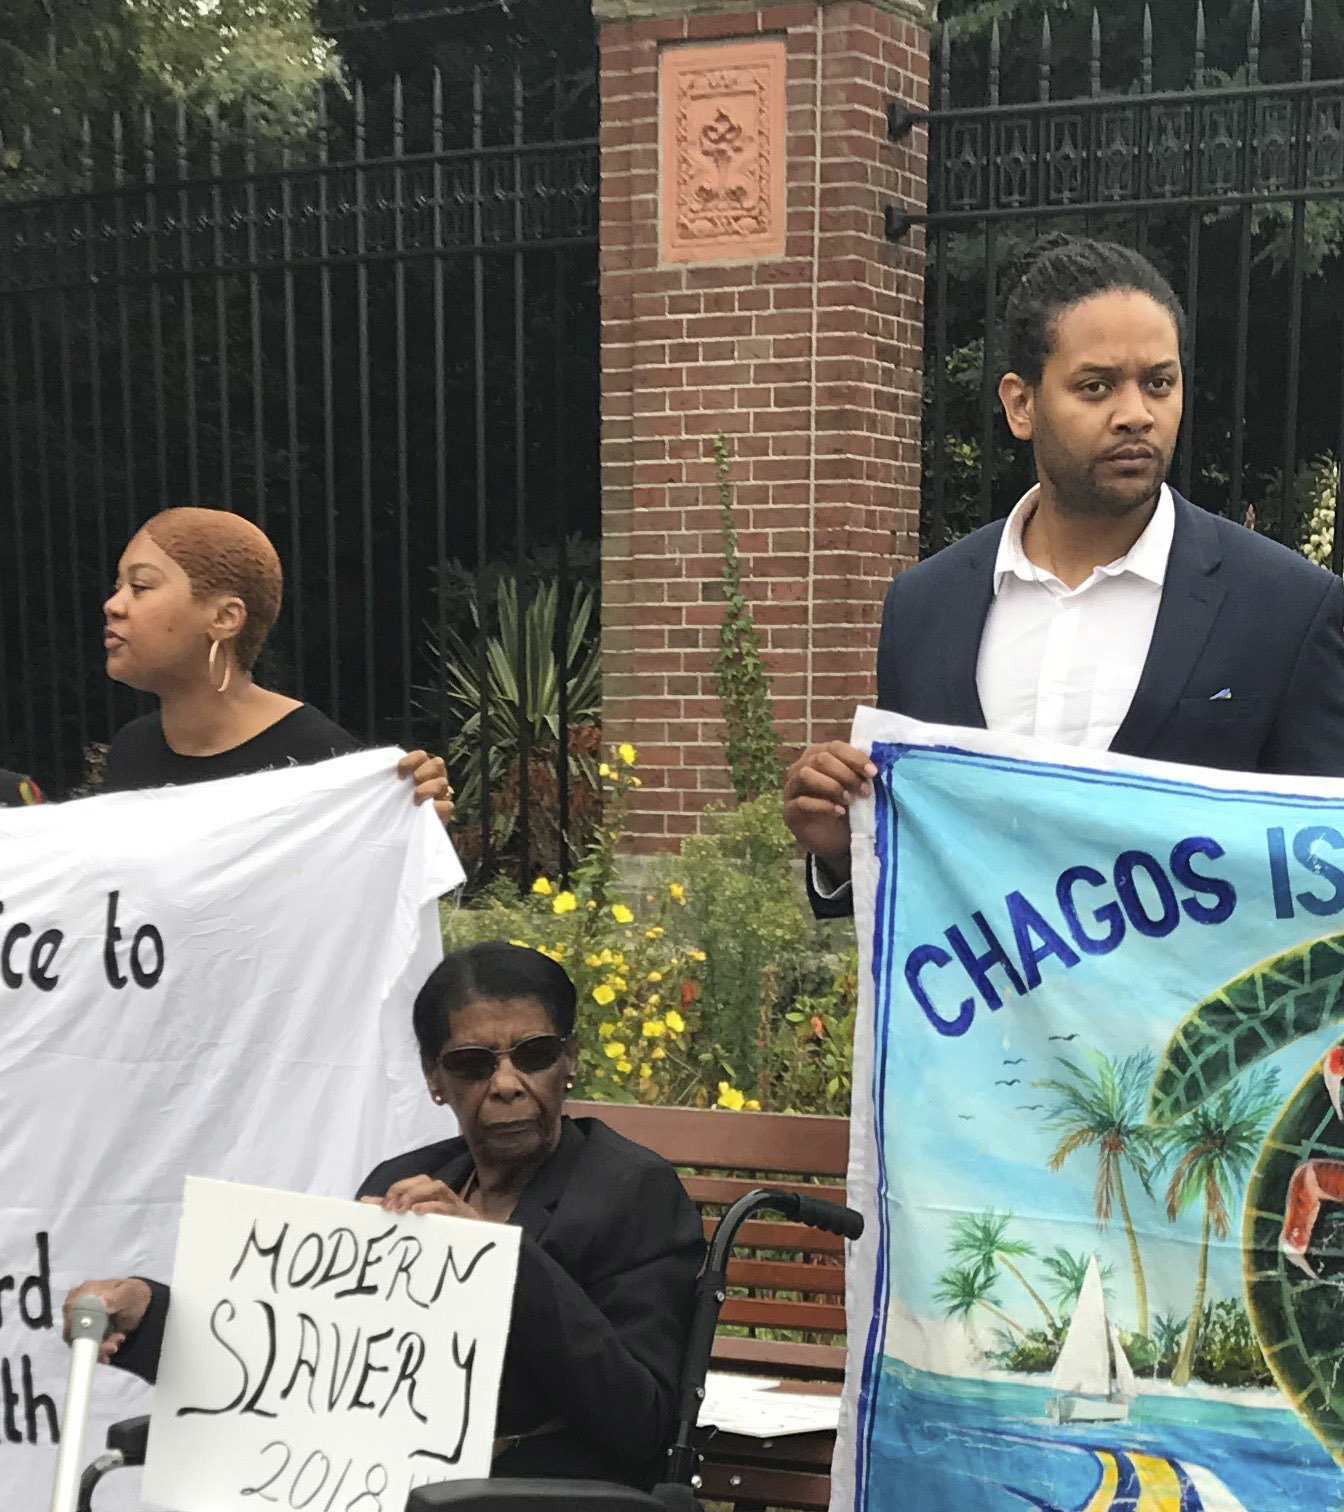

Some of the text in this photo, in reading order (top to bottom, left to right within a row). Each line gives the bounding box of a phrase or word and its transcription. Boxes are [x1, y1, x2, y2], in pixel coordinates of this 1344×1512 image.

[104, 890, 165, 989] to
[905, 836, 1237, 1037] CHAGOS
[229, 1218, 496, 1309] MODERN
[176, 1299, 477, 1465] SLAVERY
